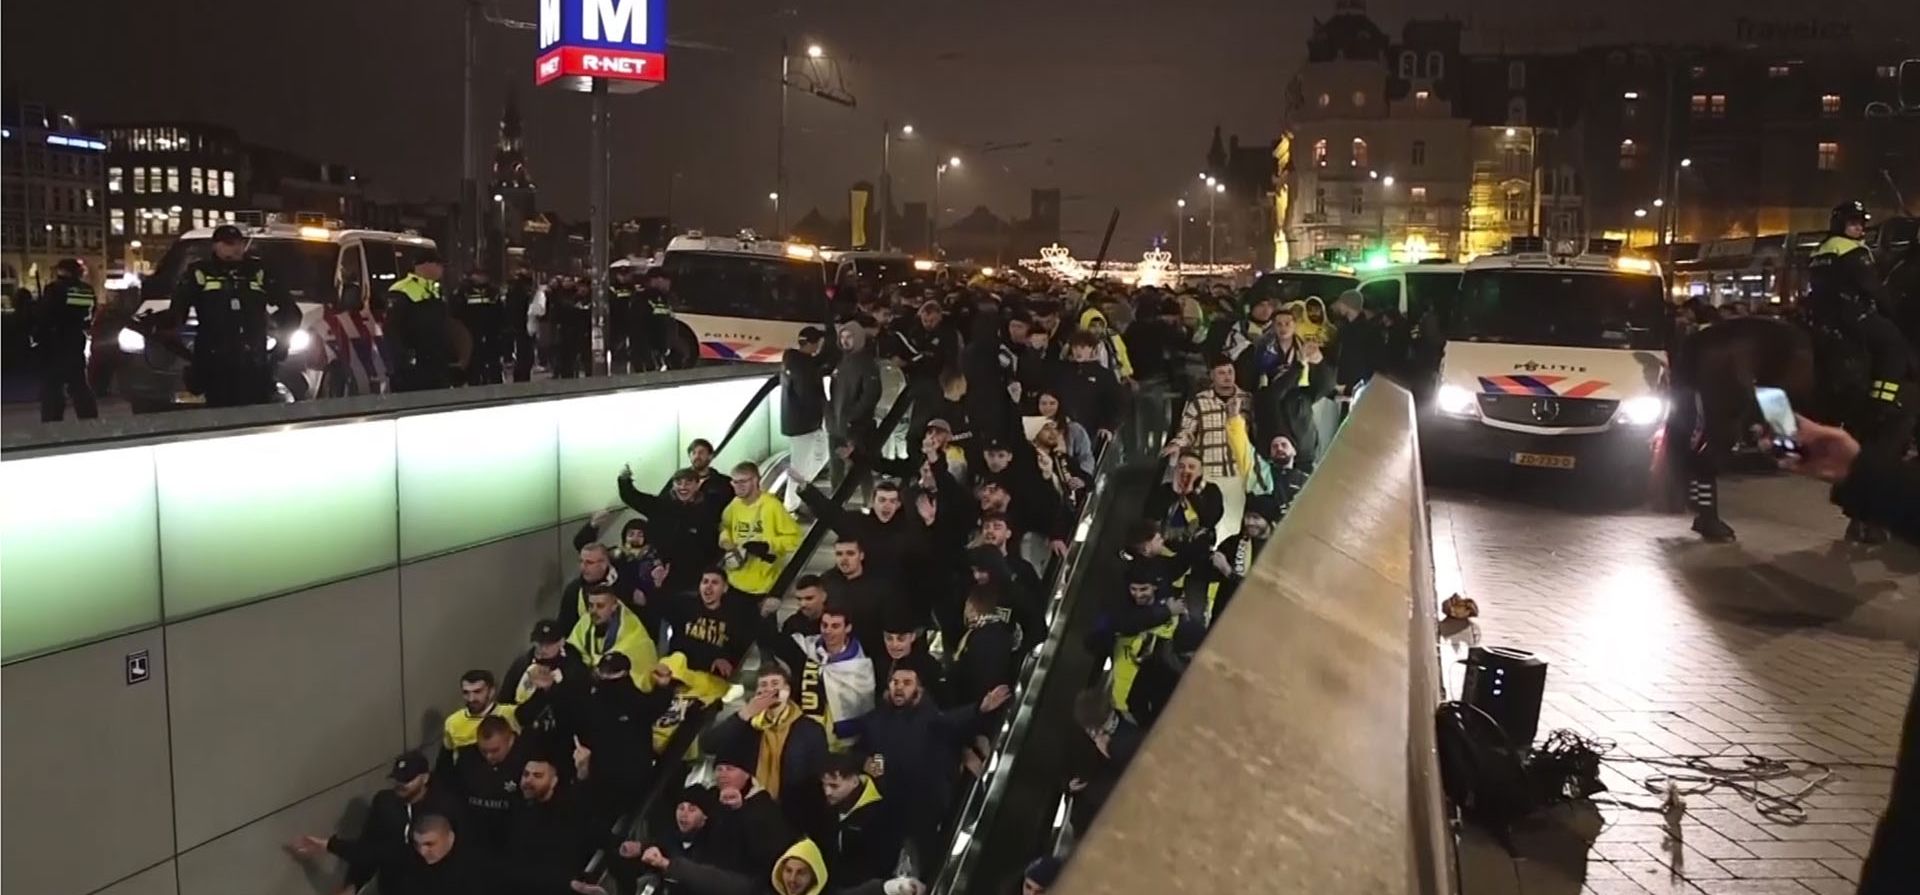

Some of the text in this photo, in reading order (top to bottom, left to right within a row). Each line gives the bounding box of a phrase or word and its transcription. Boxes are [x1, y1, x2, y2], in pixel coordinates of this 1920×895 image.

[540, 0, 560, 49] M
[582, 0, 647, 45] M
[582, 54, 647, 74] R-NET
